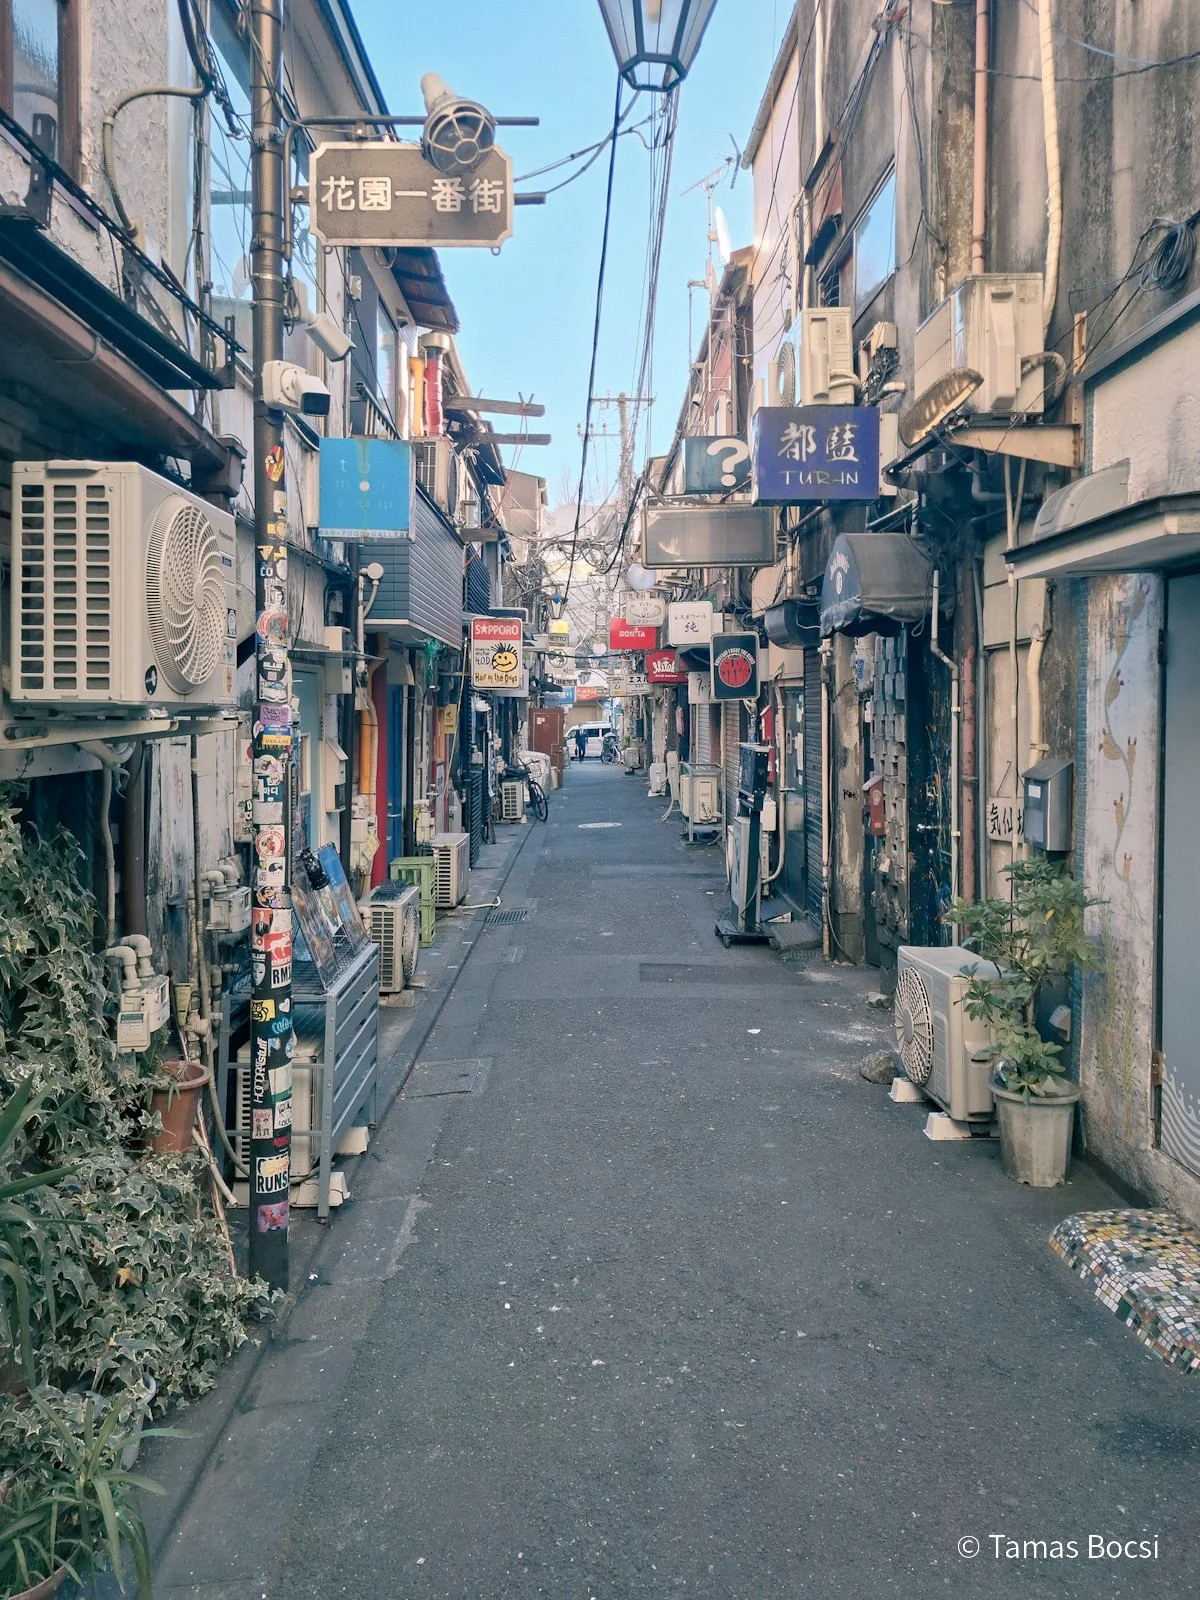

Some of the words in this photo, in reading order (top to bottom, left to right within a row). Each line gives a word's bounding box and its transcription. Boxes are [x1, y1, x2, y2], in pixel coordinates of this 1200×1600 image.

[320, 175, 504, 214] 花園一番街
[684, 622, 699, 633] 純
[257, 1171, 288, 1192] RUNS
